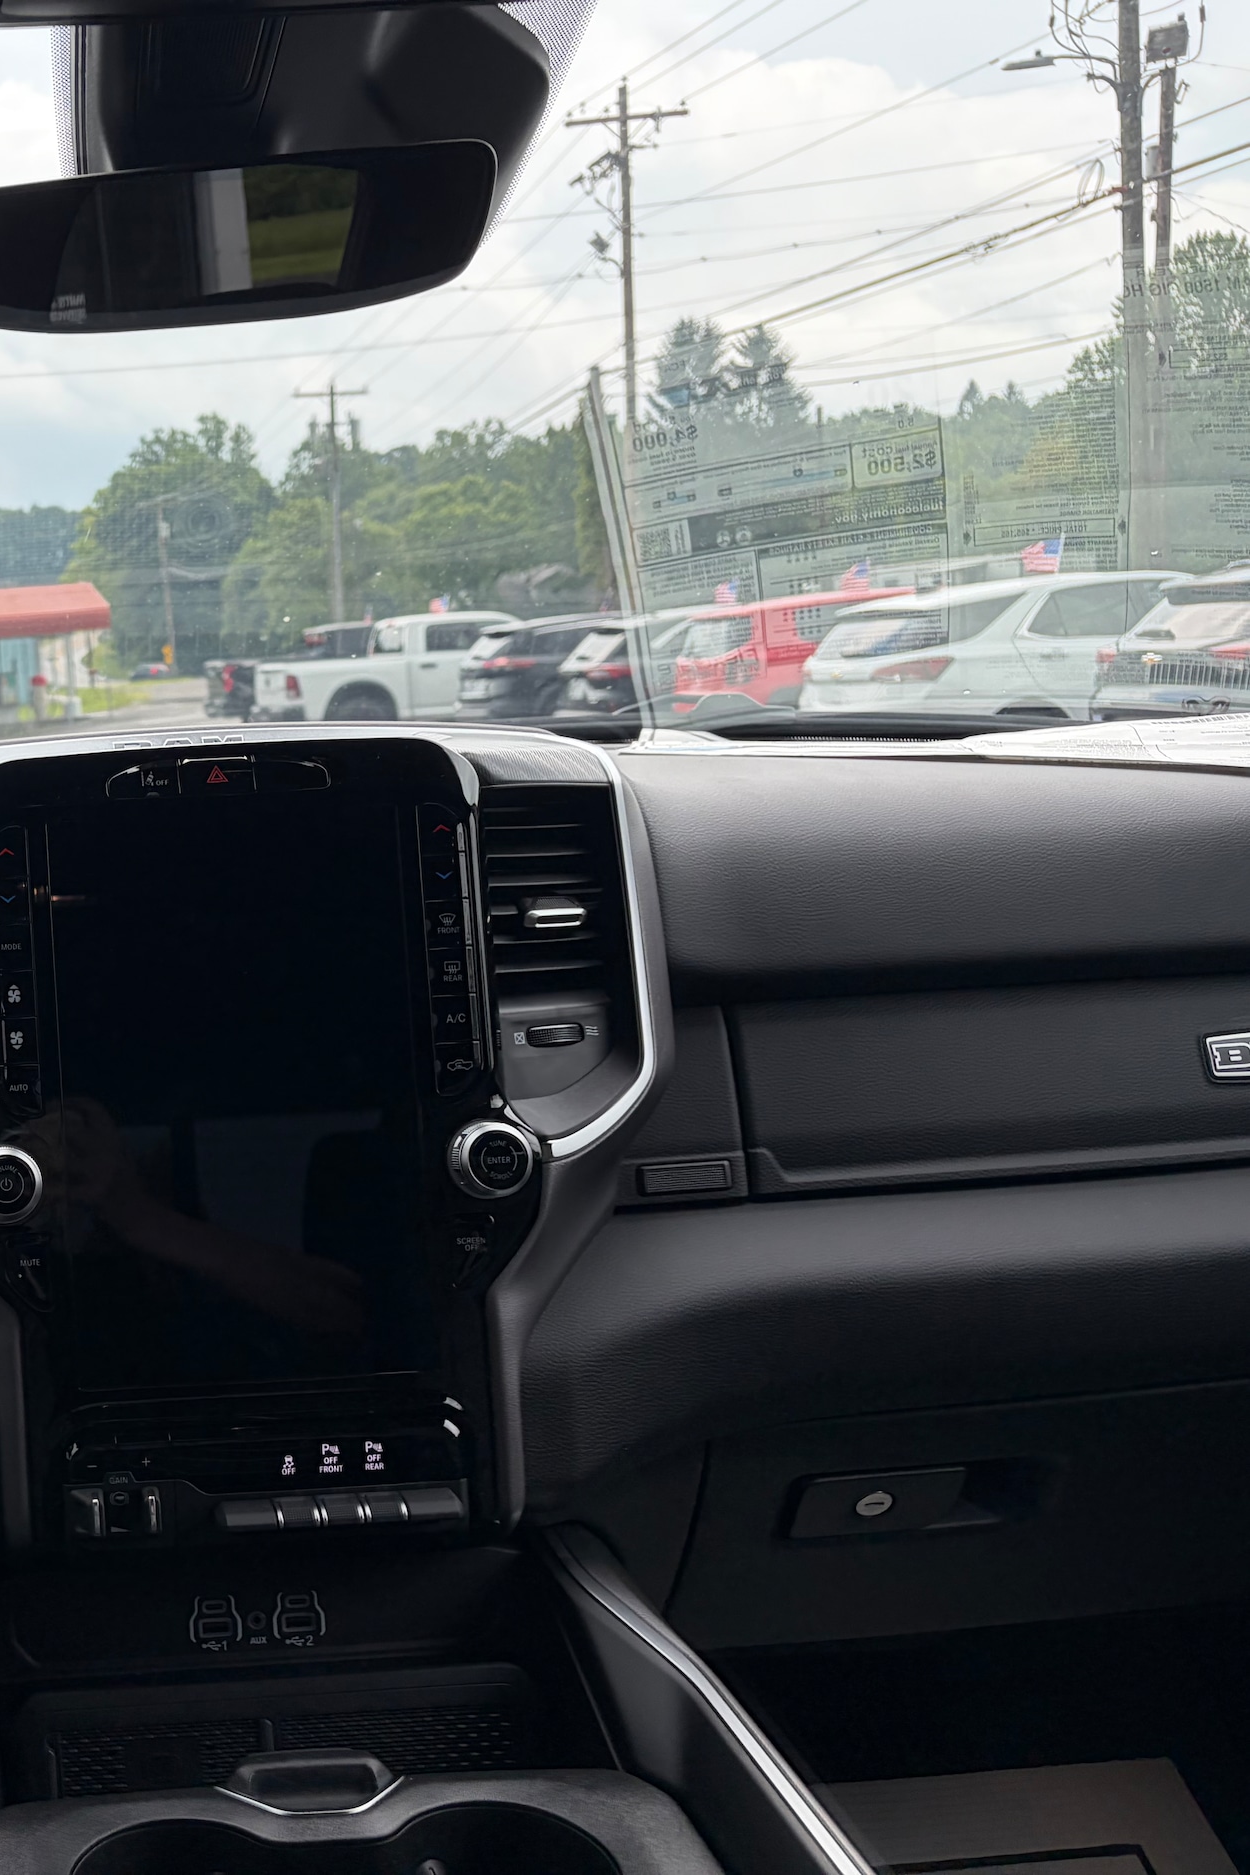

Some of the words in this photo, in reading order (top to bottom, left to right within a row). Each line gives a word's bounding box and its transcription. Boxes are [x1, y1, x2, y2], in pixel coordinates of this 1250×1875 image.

[155, 778, 170, 787] OFF
[437, 926, 461, 935] FRONT
[0, 942, 23, 951] MODE
[443, 974, 463, 982] REAR
[446, 1012, 467, 1024] A/C
[9, 1083, 29, 1092] AUTO
[487, 1155, 512, 1165] ENTER
[456, 1237, 487, 1245] SCREEN
[464, 1244, 479, 1252] OFF
[19, 1258, 41, 1267] MUTE
[323, 1456, 339, 1465] OFF
[366, 1453, 382, 1462] OFF
[319, 1464, 344, 1474] FRONT
[364, 1462, 385, 1471] REAR
[281, 1467, 297, 1476] OFF
[109, 1476, 129, 1485] GAIN
[249, 1636, 267, 1645] AUX
[305, 1635, 315, 1646] 2
